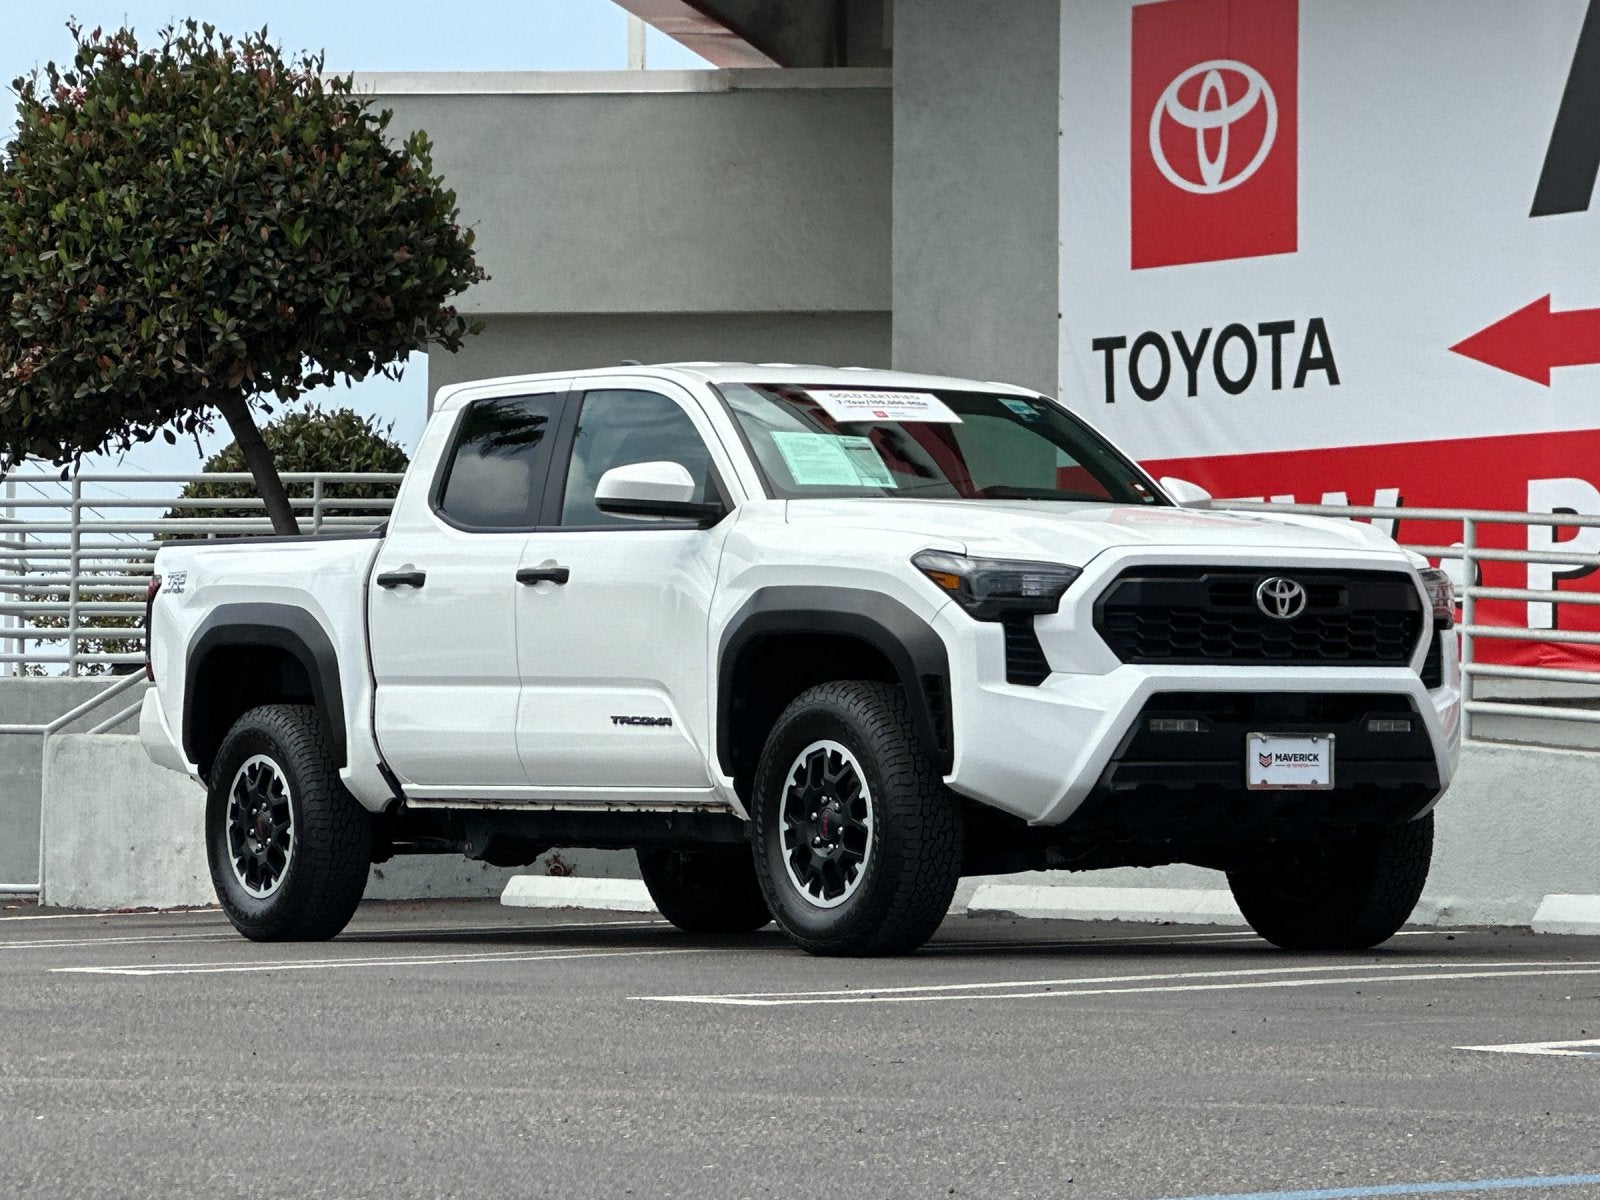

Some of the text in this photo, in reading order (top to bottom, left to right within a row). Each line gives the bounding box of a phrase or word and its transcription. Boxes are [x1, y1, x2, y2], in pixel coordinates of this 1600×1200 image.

[1092, 317, 1341, 404] TOYOTA
[610, 715, 673, 727] TACOMA
[1275, 753, 1320, 762] MAVERICK
